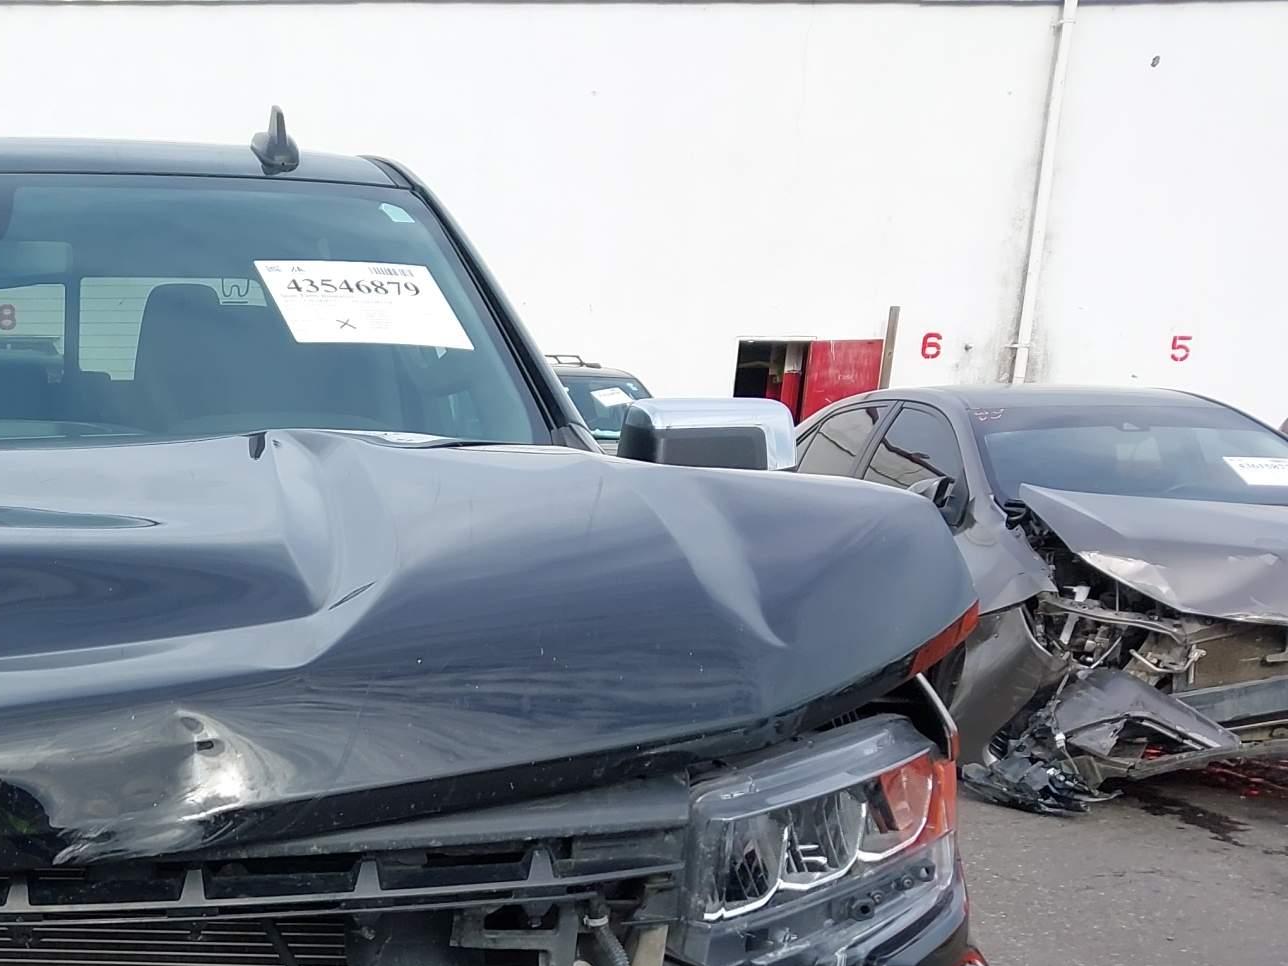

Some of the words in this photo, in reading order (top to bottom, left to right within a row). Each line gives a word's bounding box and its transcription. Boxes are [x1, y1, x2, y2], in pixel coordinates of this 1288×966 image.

[286, 278, 420, 297] 43546879
[920, 332, 943, 360] 6
[1170, 335, 1192, 362] 5
